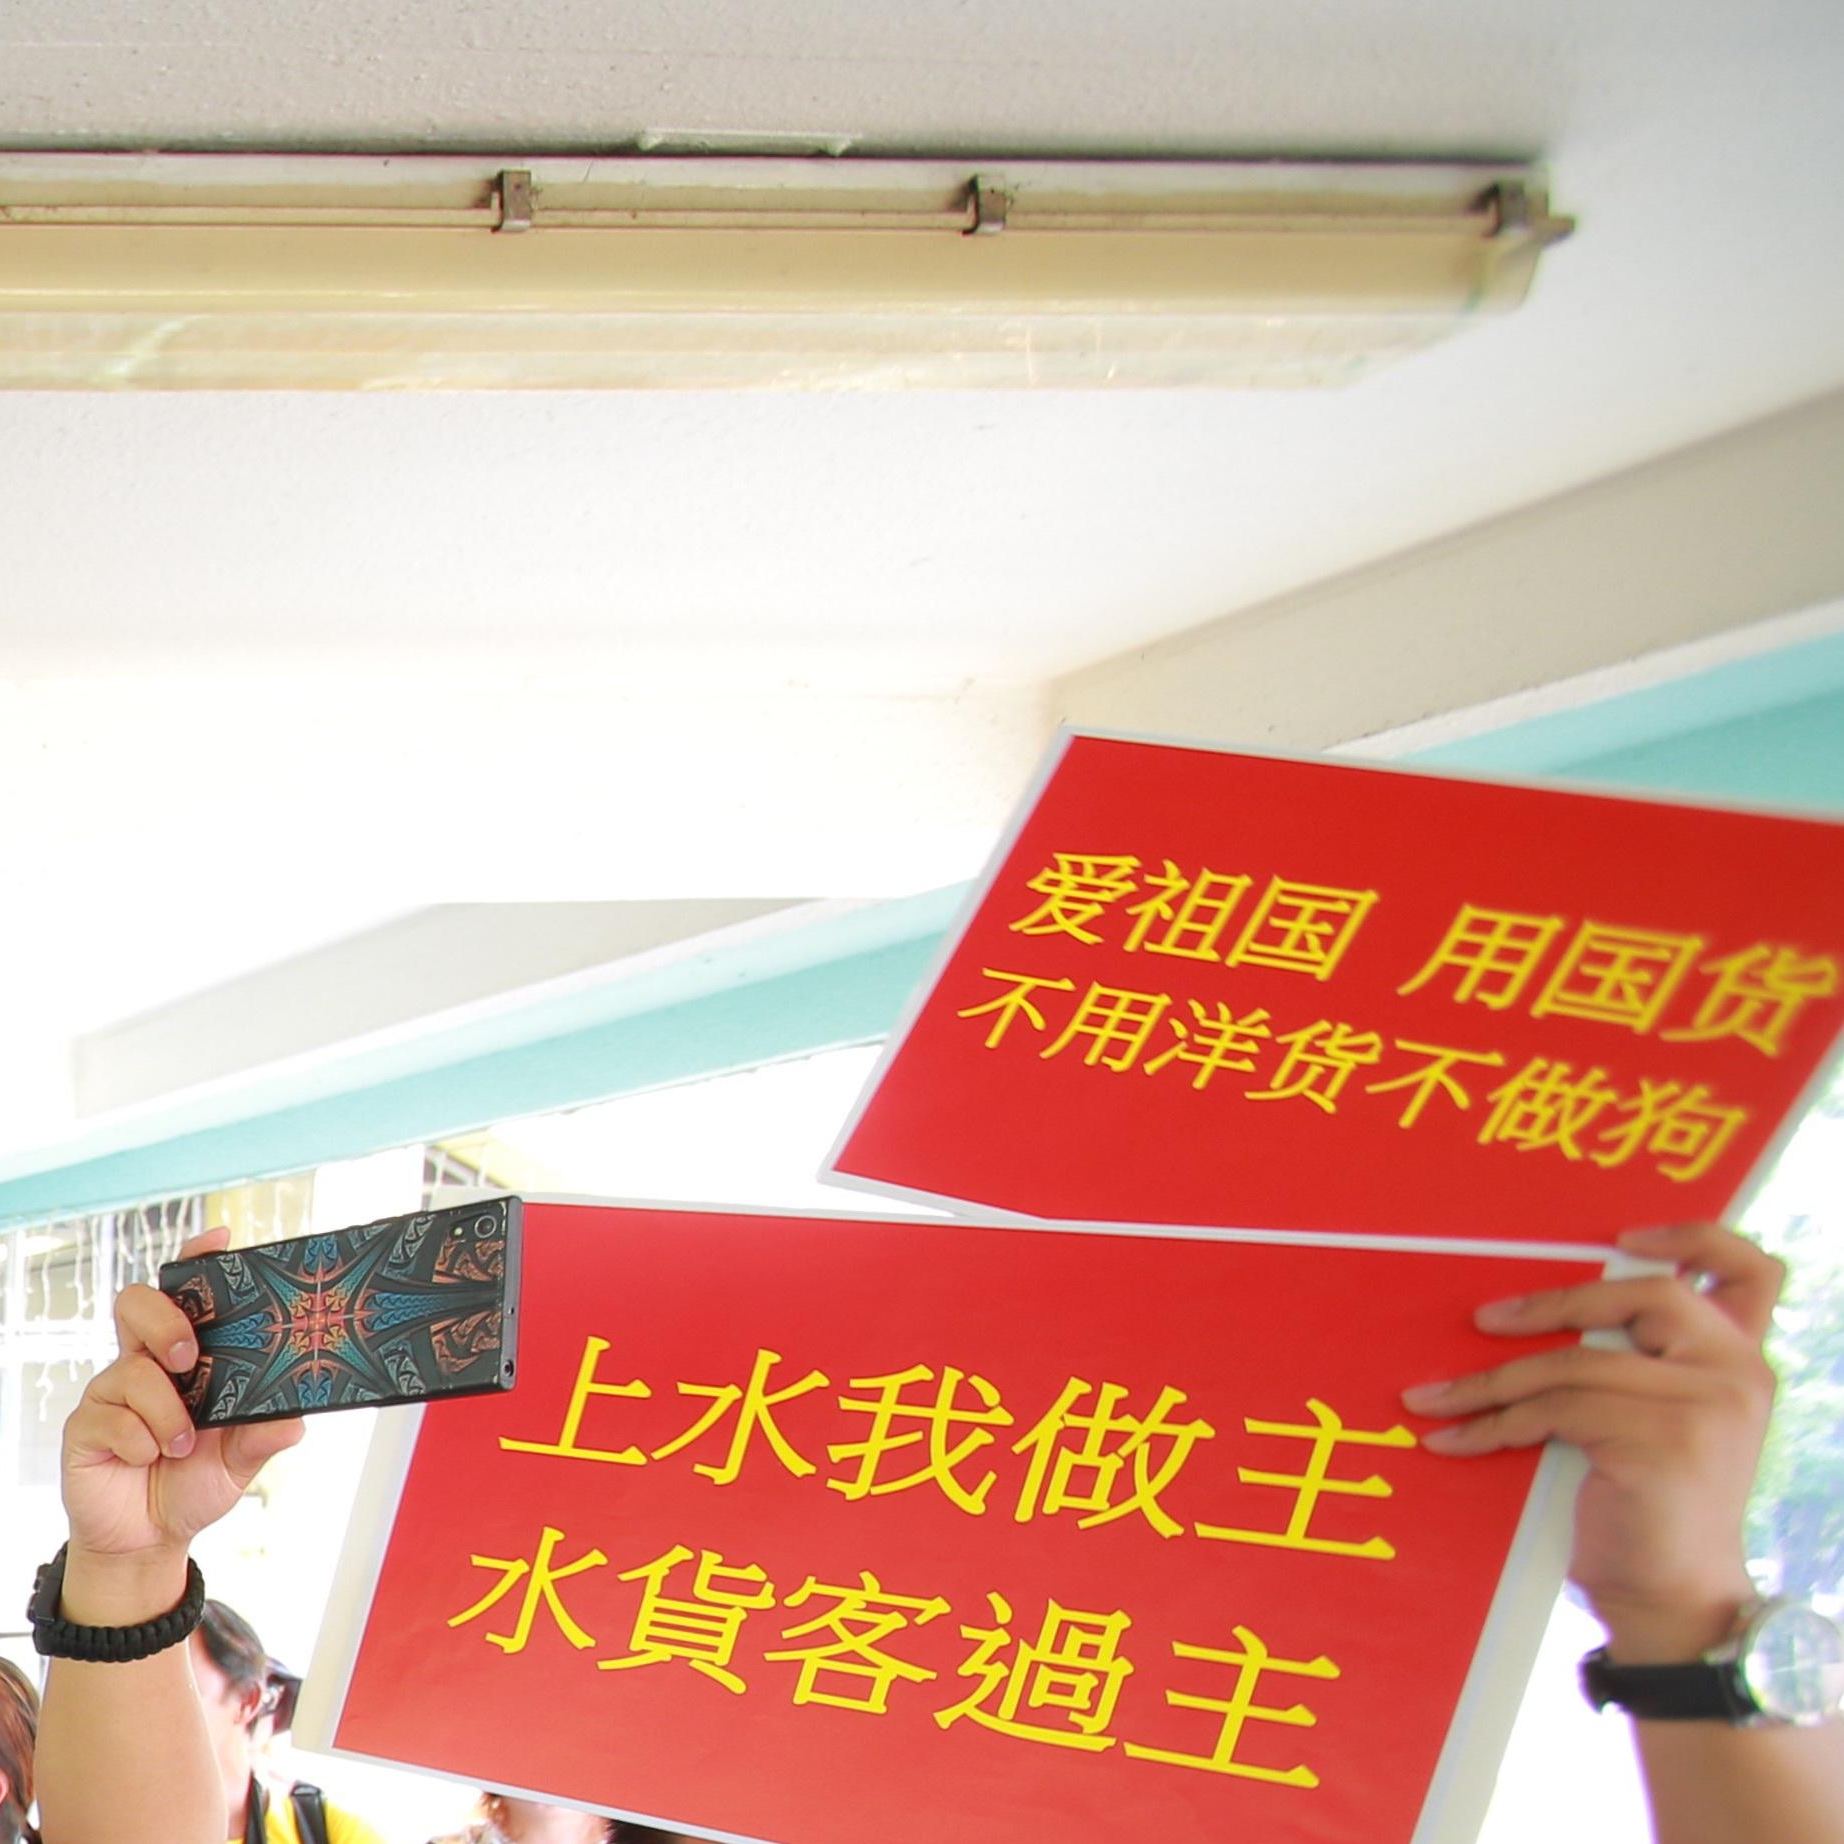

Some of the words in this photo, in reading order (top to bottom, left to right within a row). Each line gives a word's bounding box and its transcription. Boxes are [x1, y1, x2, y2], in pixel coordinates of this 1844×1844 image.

[1007, 851, 1379, 982] 爱祖国
[1398, 903, 1840, 1057] 用国货
[957, 967, 1749, 1183] 不用洋货不做狗
[496, 1335, 1417, 1562] 上水我做主
[447, 1526, 1341, 1789] 水貨客過主
